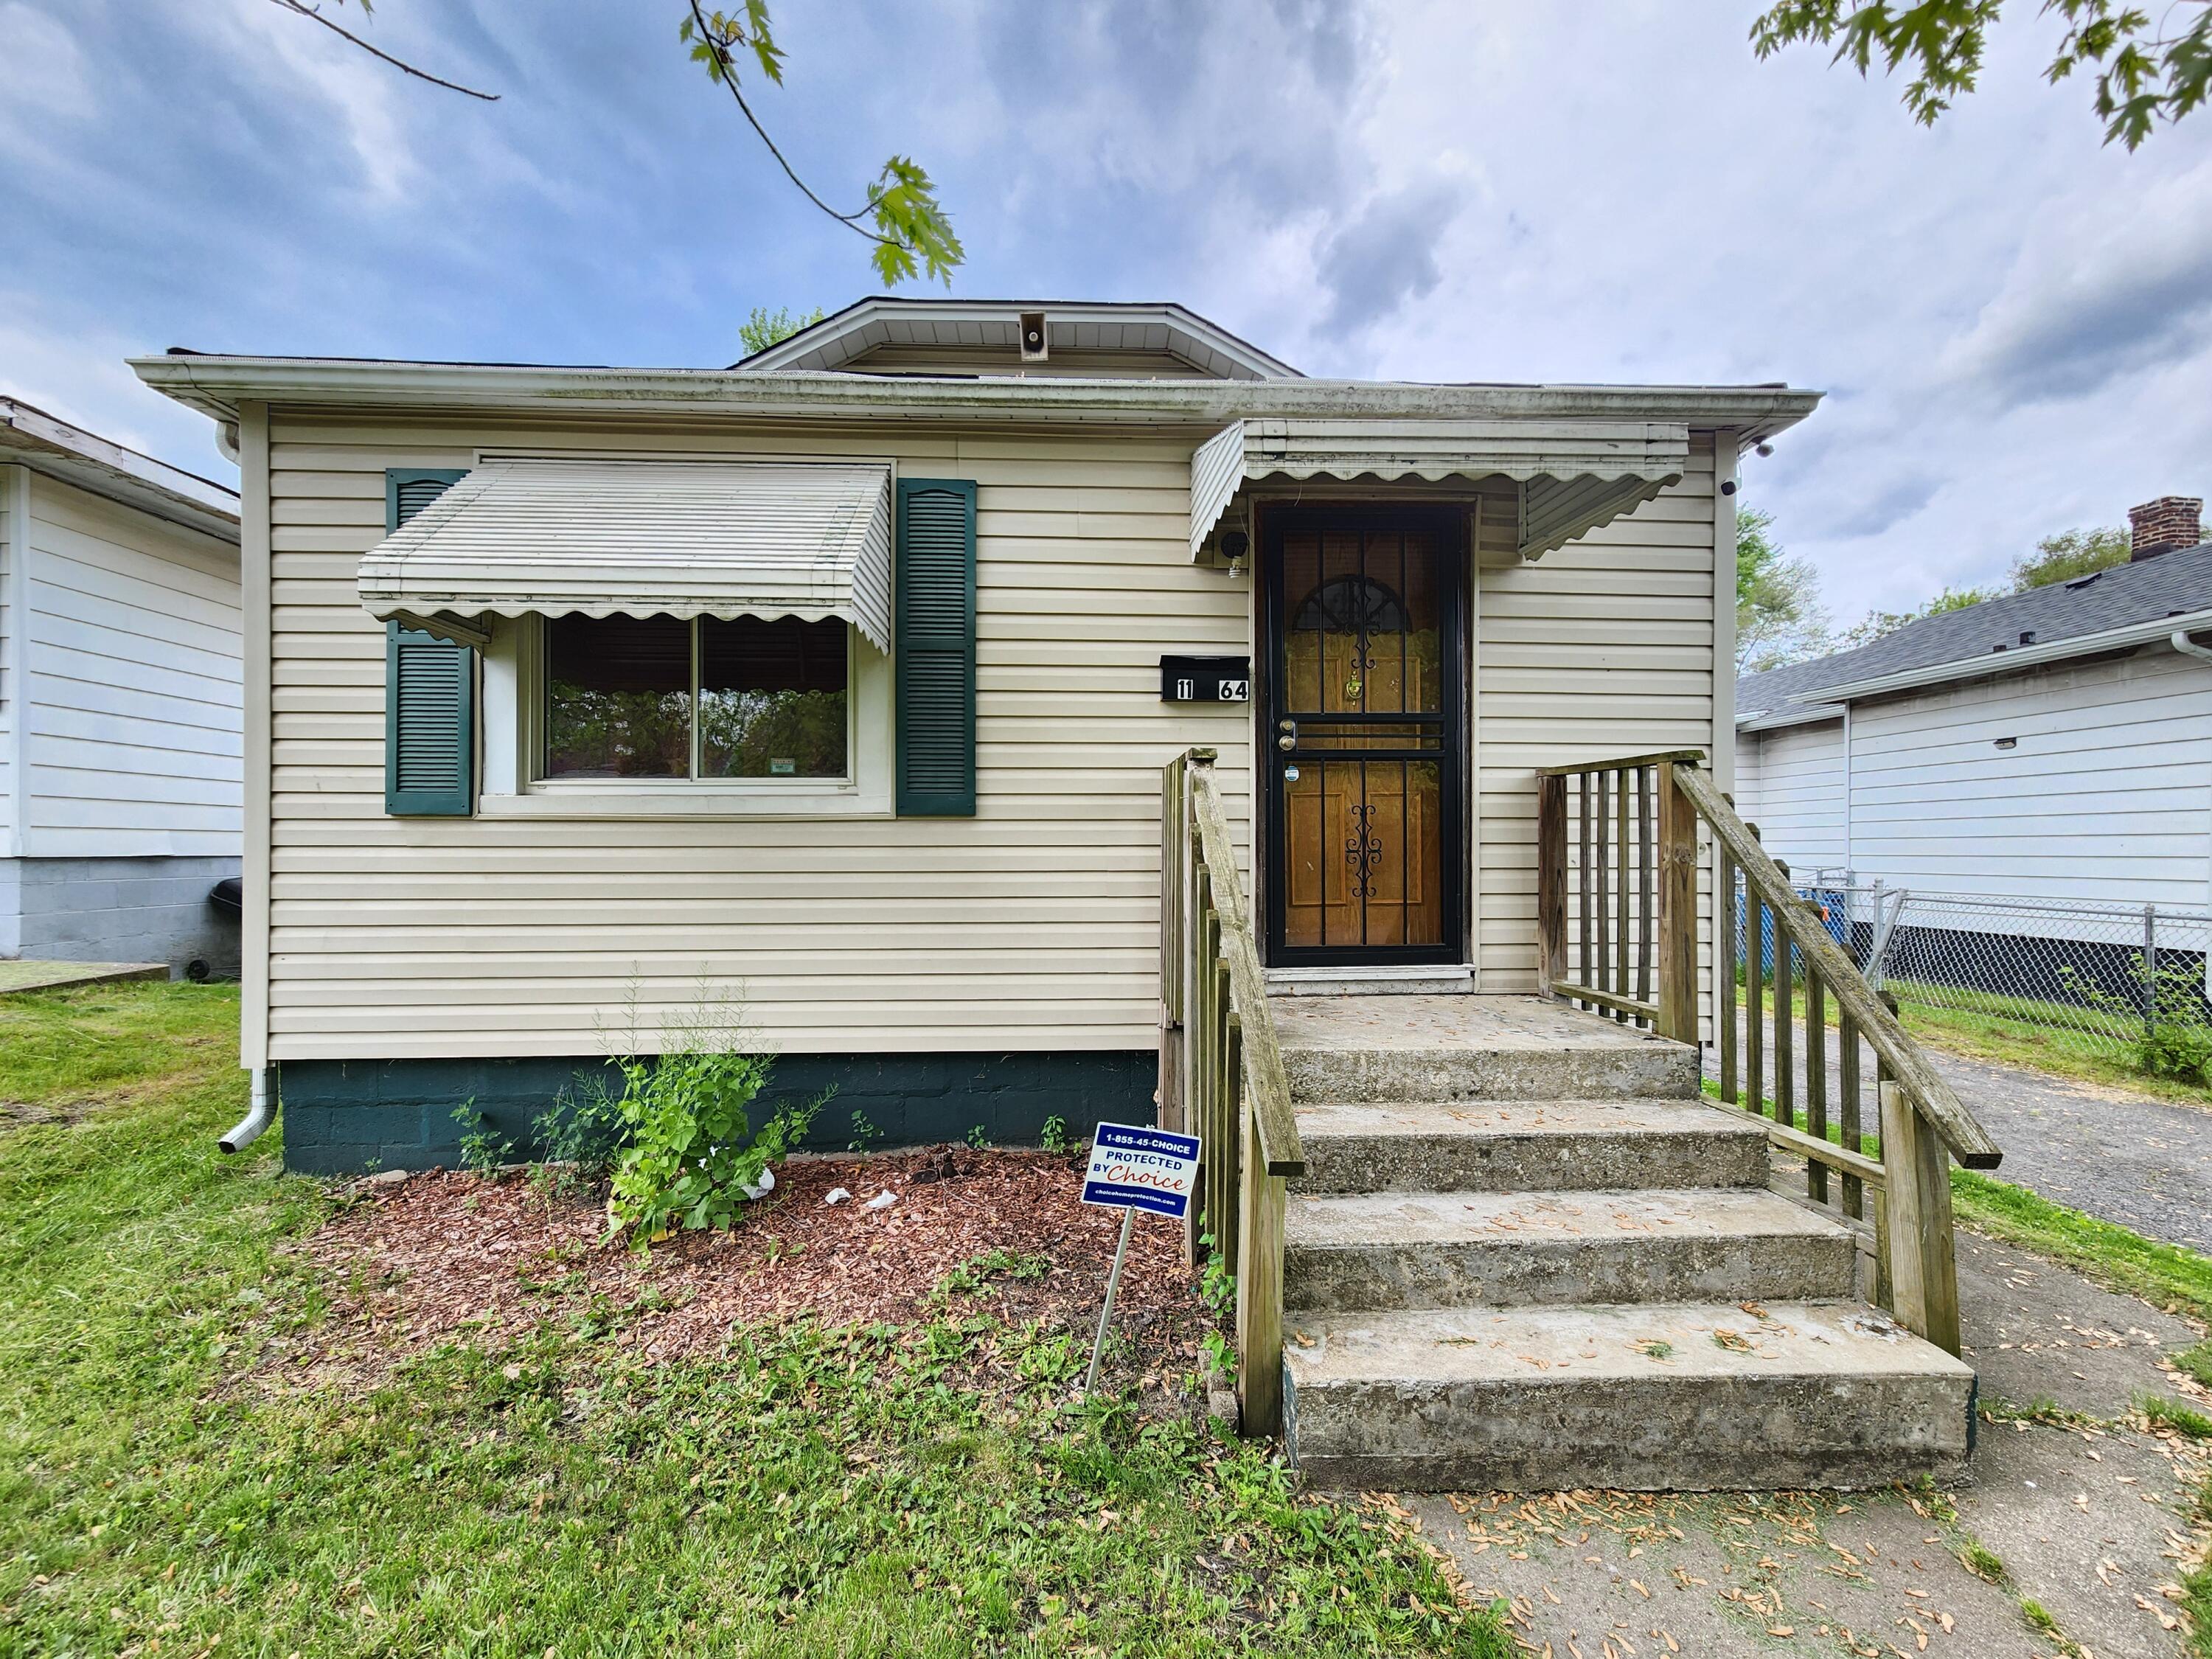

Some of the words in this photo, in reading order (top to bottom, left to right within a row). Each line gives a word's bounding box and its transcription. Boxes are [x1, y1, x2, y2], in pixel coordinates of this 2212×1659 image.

[1179, 681, 1192, 698] 11
[1220, 681, 1248, 700] 64
[1106, 1134, 1190, 1154] 1-855-45-CHOICE
[1106, 1151, 1182, 1170] PROTECTED
[1093, 1164, 1110, 1172] BY
[1107, 1165, 1188, 1190] Choice
[1095, 1189, 1175, 1206] choicehomeprotection.com
